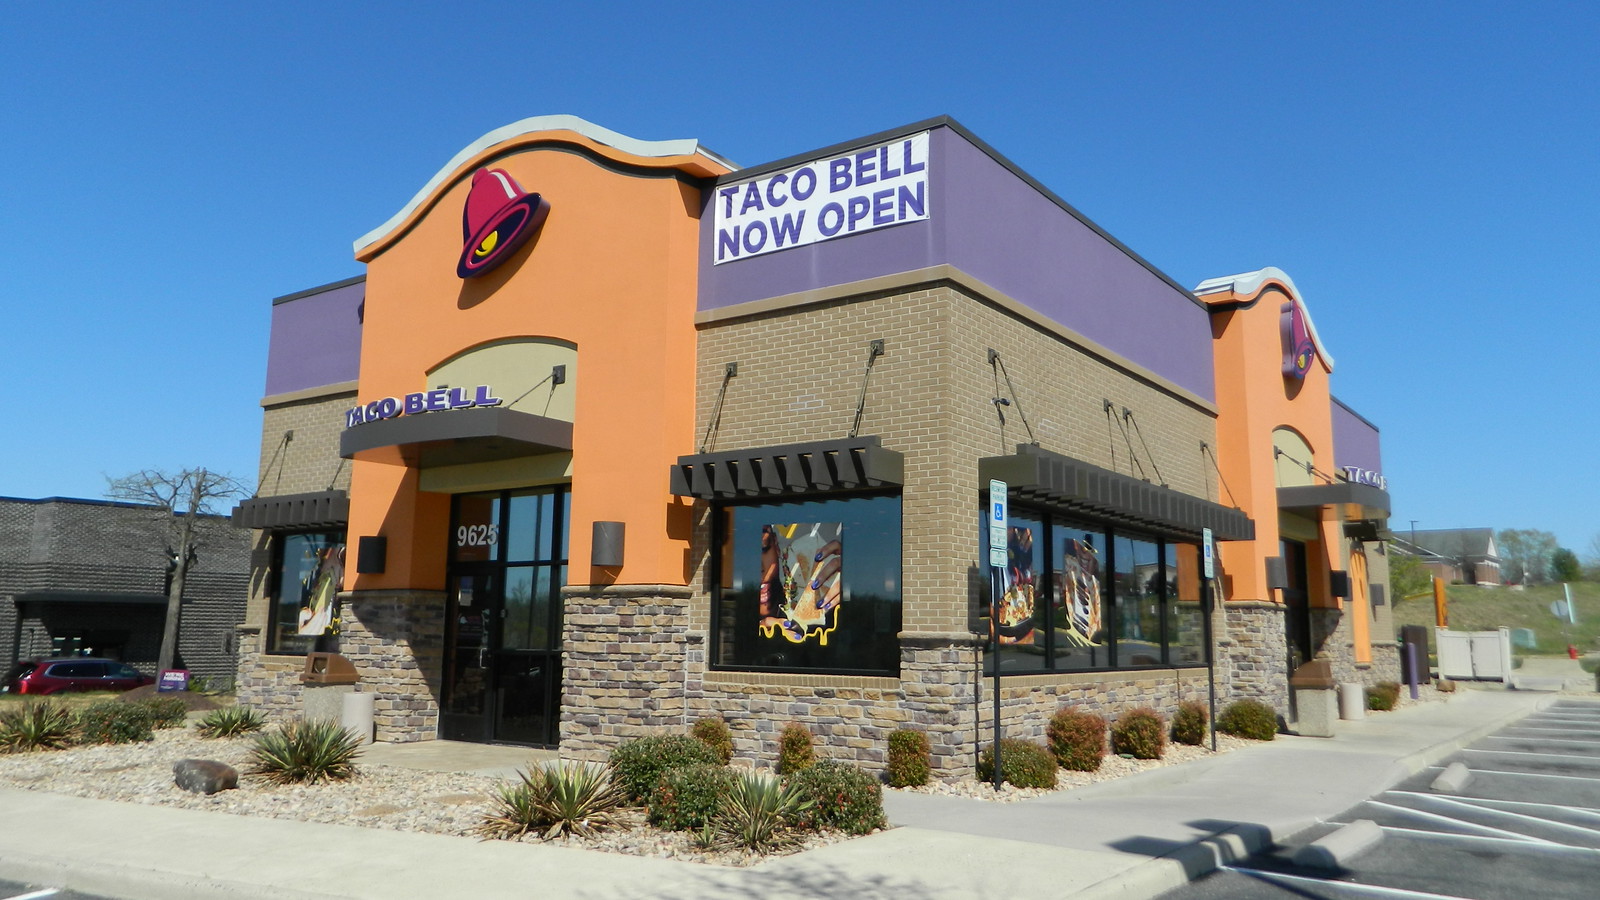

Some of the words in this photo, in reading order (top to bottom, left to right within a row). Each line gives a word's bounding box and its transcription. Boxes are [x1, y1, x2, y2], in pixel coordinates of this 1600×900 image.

[720, 167, 817, 218] TACO
[830, 140, 925, 193] BELL
[718, 209, 806, 260] NOW
[817, 180, 925, 236] OPEN
[345, 397, 403, 428] TACO
[405, 385, 502, 415] BELL
[457, 524, 498, 546] 9625
